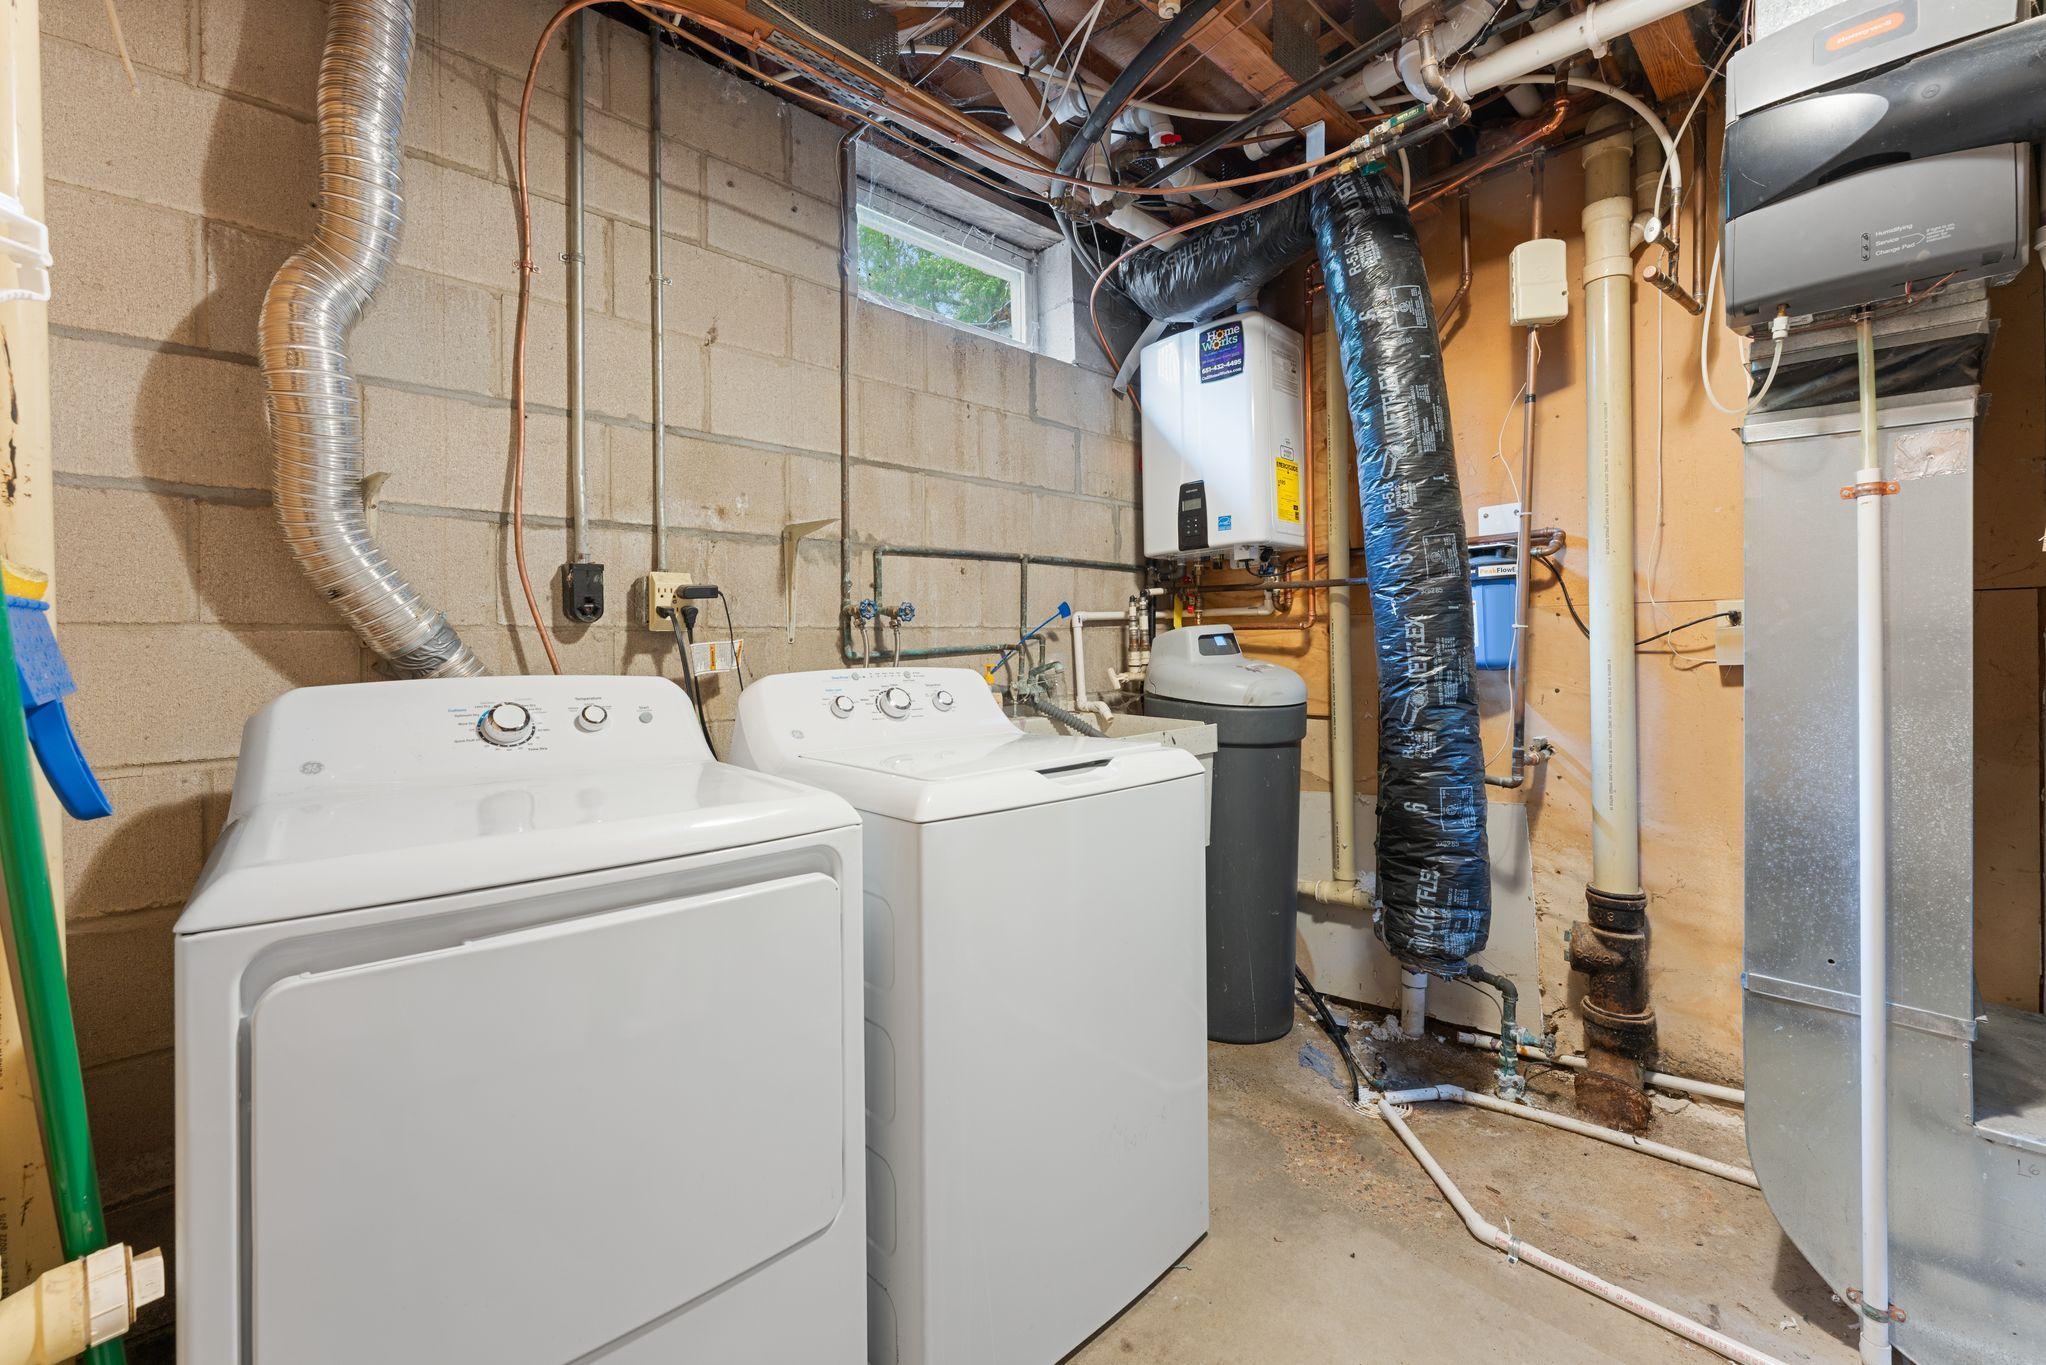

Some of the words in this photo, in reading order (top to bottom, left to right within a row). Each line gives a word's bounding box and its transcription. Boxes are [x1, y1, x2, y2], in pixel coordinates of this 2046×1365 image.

[1875, 224, 1913, 237] Humidifying
[1875, 237, 1900, 247] Service
[1875, 247, 1901, 256] Change
[1901, 242, 1916, 250] Pad
[1344, 246, 1361, 277] R-5.8
[1206, 325, 1240, 342] Home
